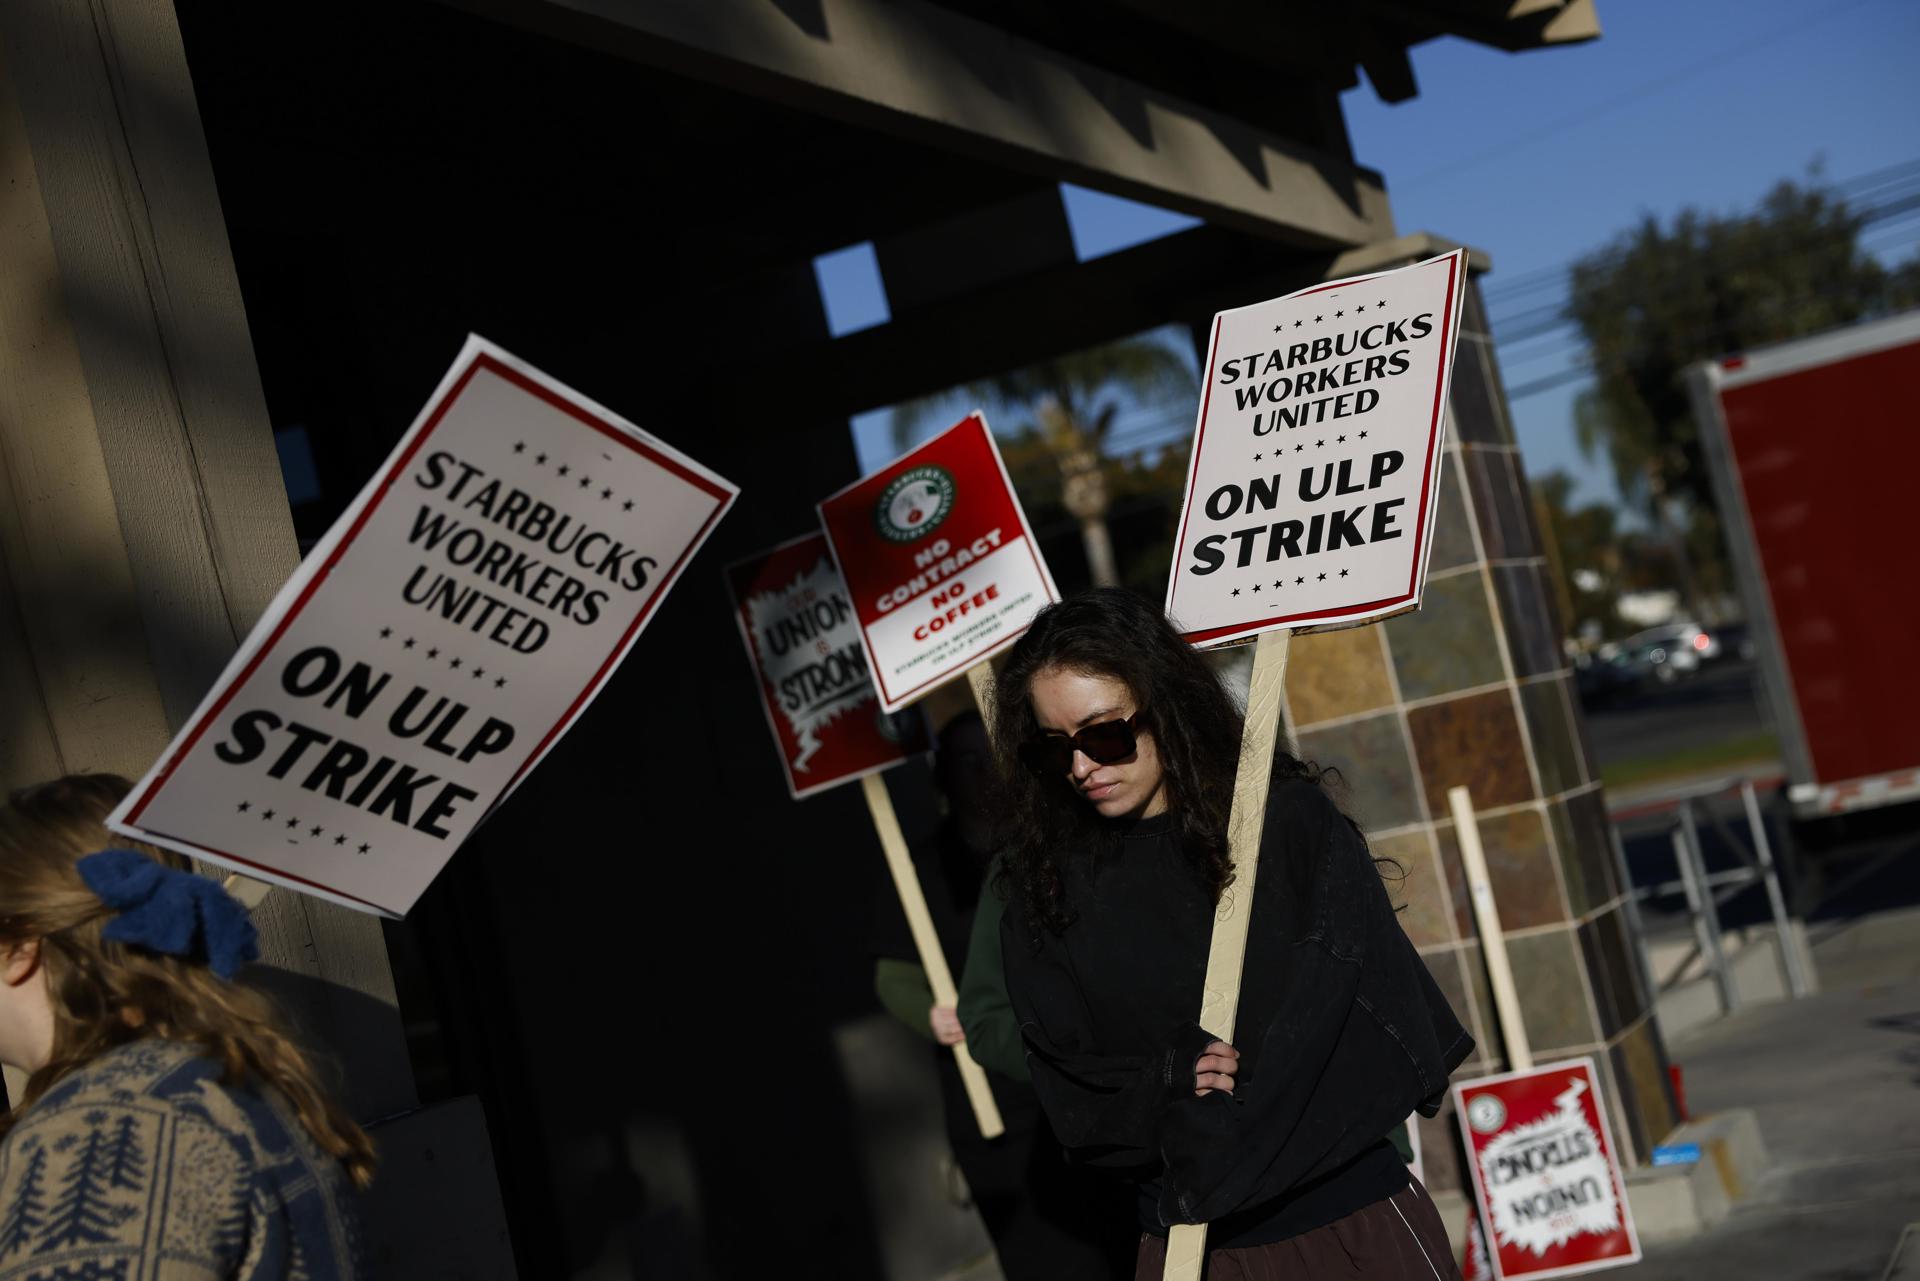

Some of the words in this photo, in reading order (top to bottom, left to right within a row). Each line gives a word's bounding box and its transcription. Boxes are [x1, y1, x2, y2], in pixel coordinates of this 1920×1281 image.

[1220, 313, 1433, 385] STARBUCKS
[1235, 349, 1410, 412] WORKERS
[1252, 388, 1380, 437] UNITED
[415, 451, 658, 592] STARBUCKS
[1205, 474, 1281, 521] ON
[1298, 450, 1405, 502] ULP
[406, 505, 610, 626] WORKERS
[876, 527, 1003, 613] CONTRACT
[914, 538, 951, 570] NO
[1190, 498, 1406, 576] STRIKE
[402, 565, 550, 655] UNITED
[913, 583, 1001, 642] COFFEE
[931, 581, 966, 611] NO
[281, 646, 391, 719] ON
[388, 686, 515, 764] ULP
[214, 709, 478, 841] STRIKE
[1510, 1176, 1602, 1225] UNION
